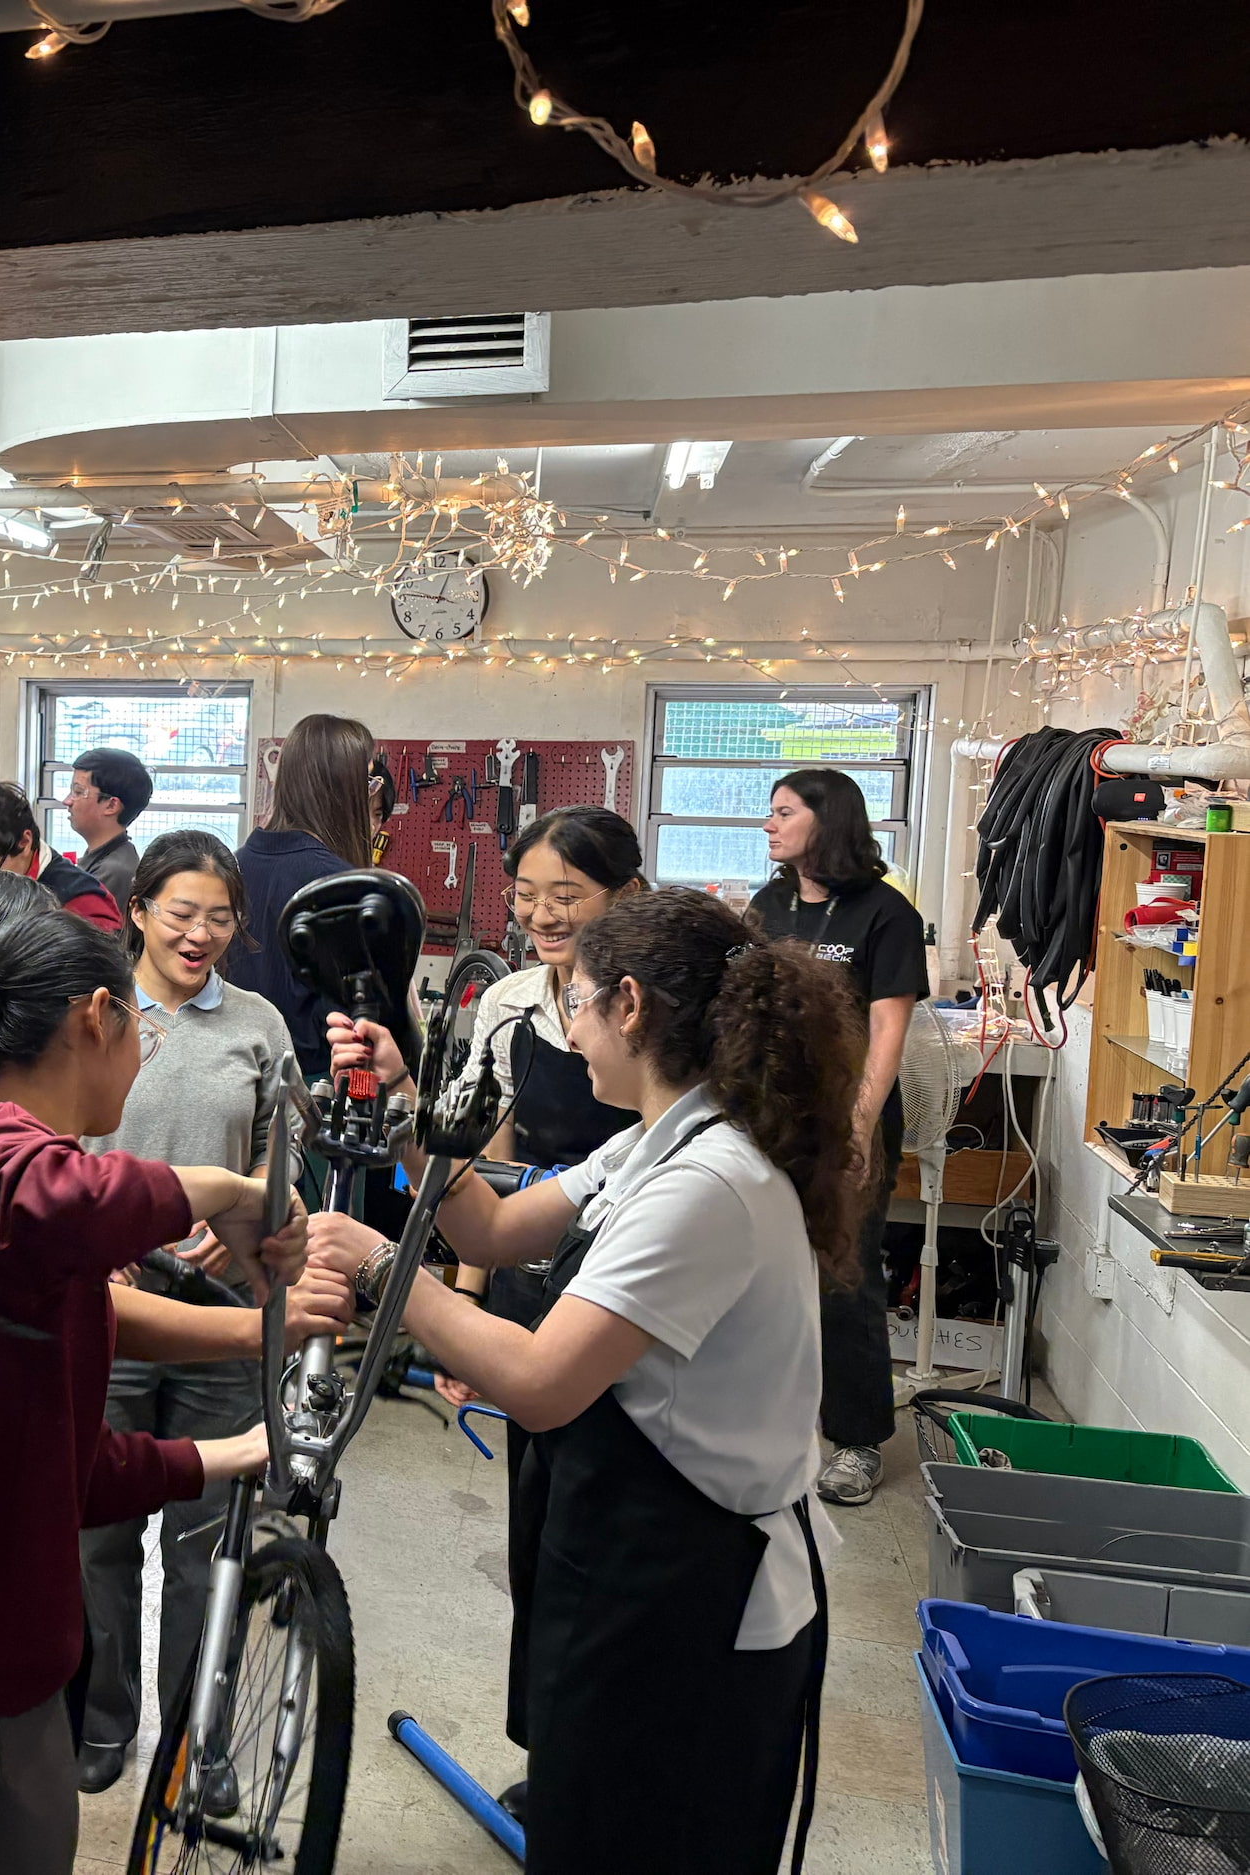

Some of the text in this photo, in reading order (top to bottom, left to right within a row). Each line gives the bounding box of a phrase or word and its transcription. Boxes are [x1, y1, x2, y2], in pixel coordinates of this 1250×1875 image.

[433, 556, 446, 567] 12
[403, 611, 412, 623] 8
[466, 608, 475, 620] 4
[418, 624, 426, 637] 7
[435, 627, 444, 640] 6
[452, 623, 461, 635] 5
[818, 944, 855, 956] COOP
[816, 952, 852, 963] BECIK
